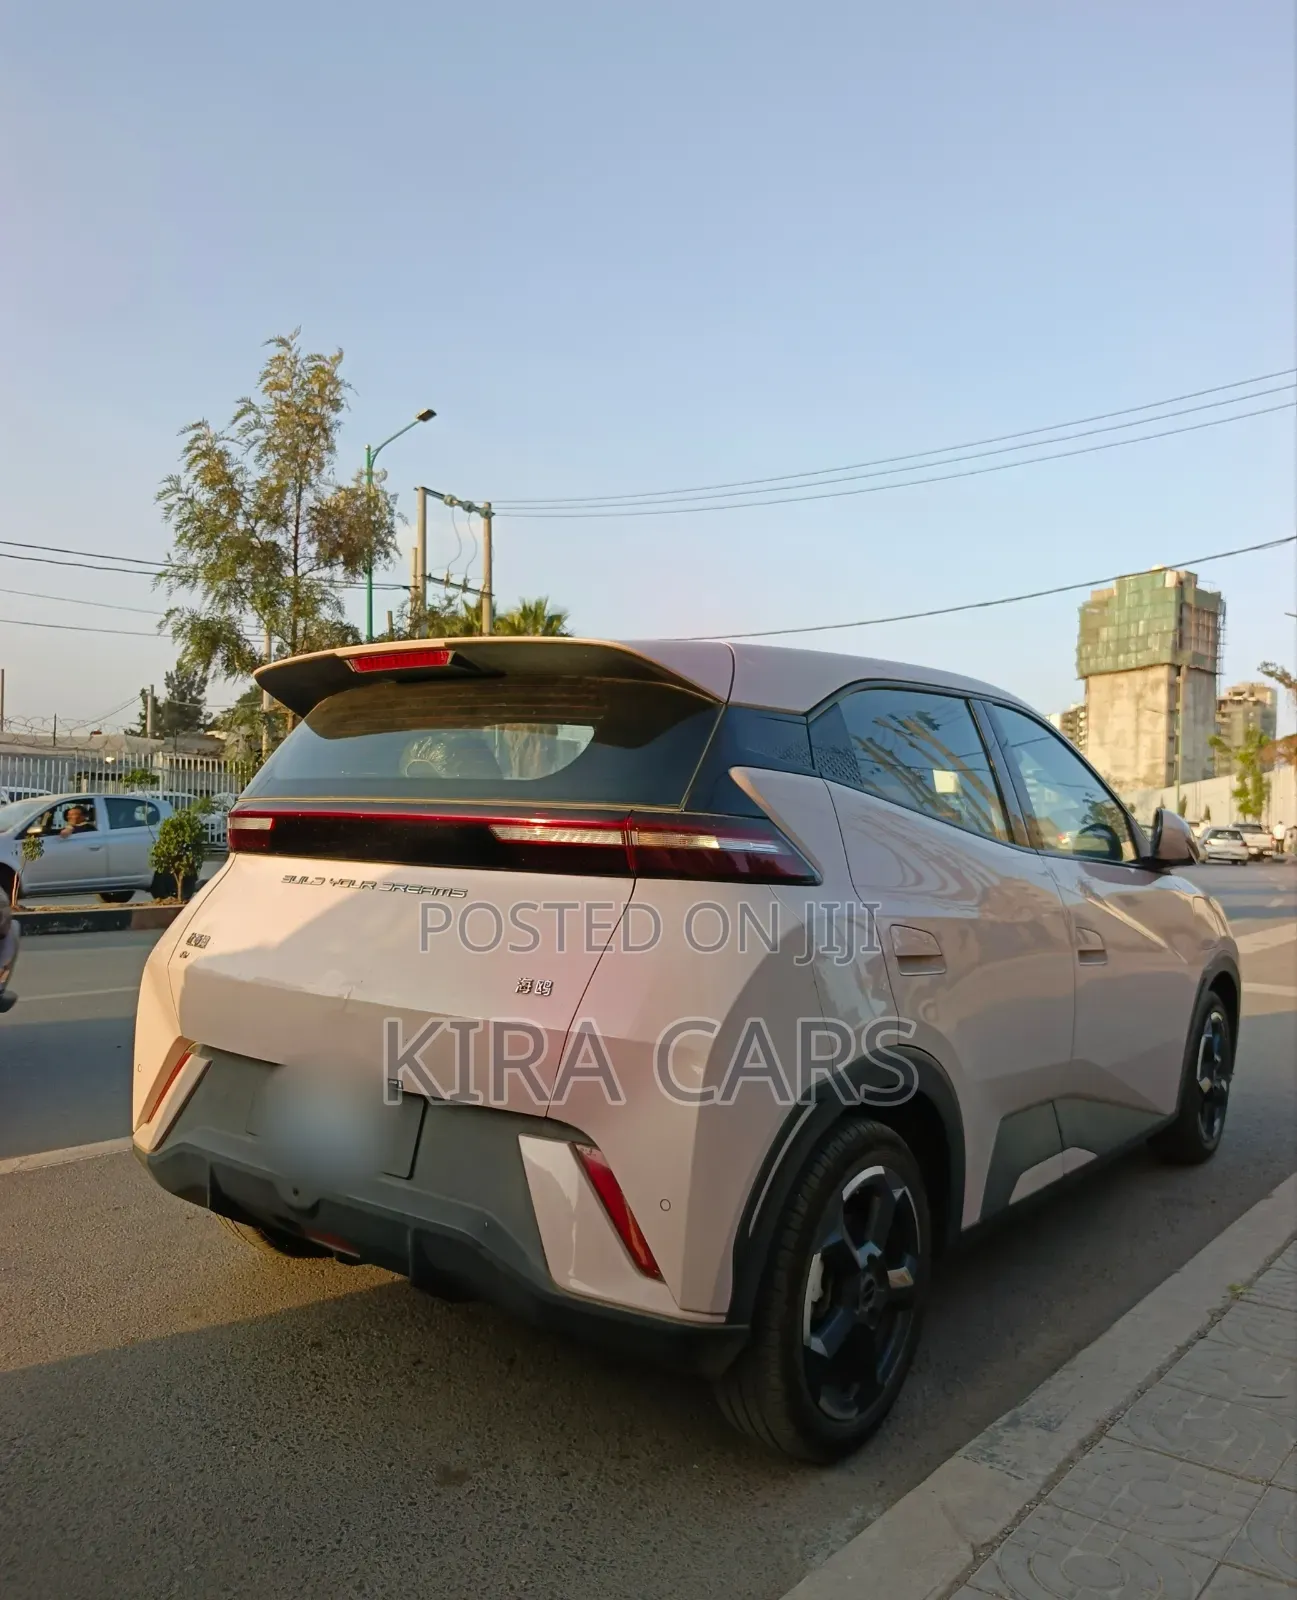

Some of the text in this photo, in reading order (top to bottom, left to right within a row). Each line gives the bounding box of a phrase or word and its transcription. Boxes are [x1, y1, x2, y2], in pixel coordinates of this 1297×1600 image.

[281, 874, 468, 898] BUILD YOUR DREAMS
